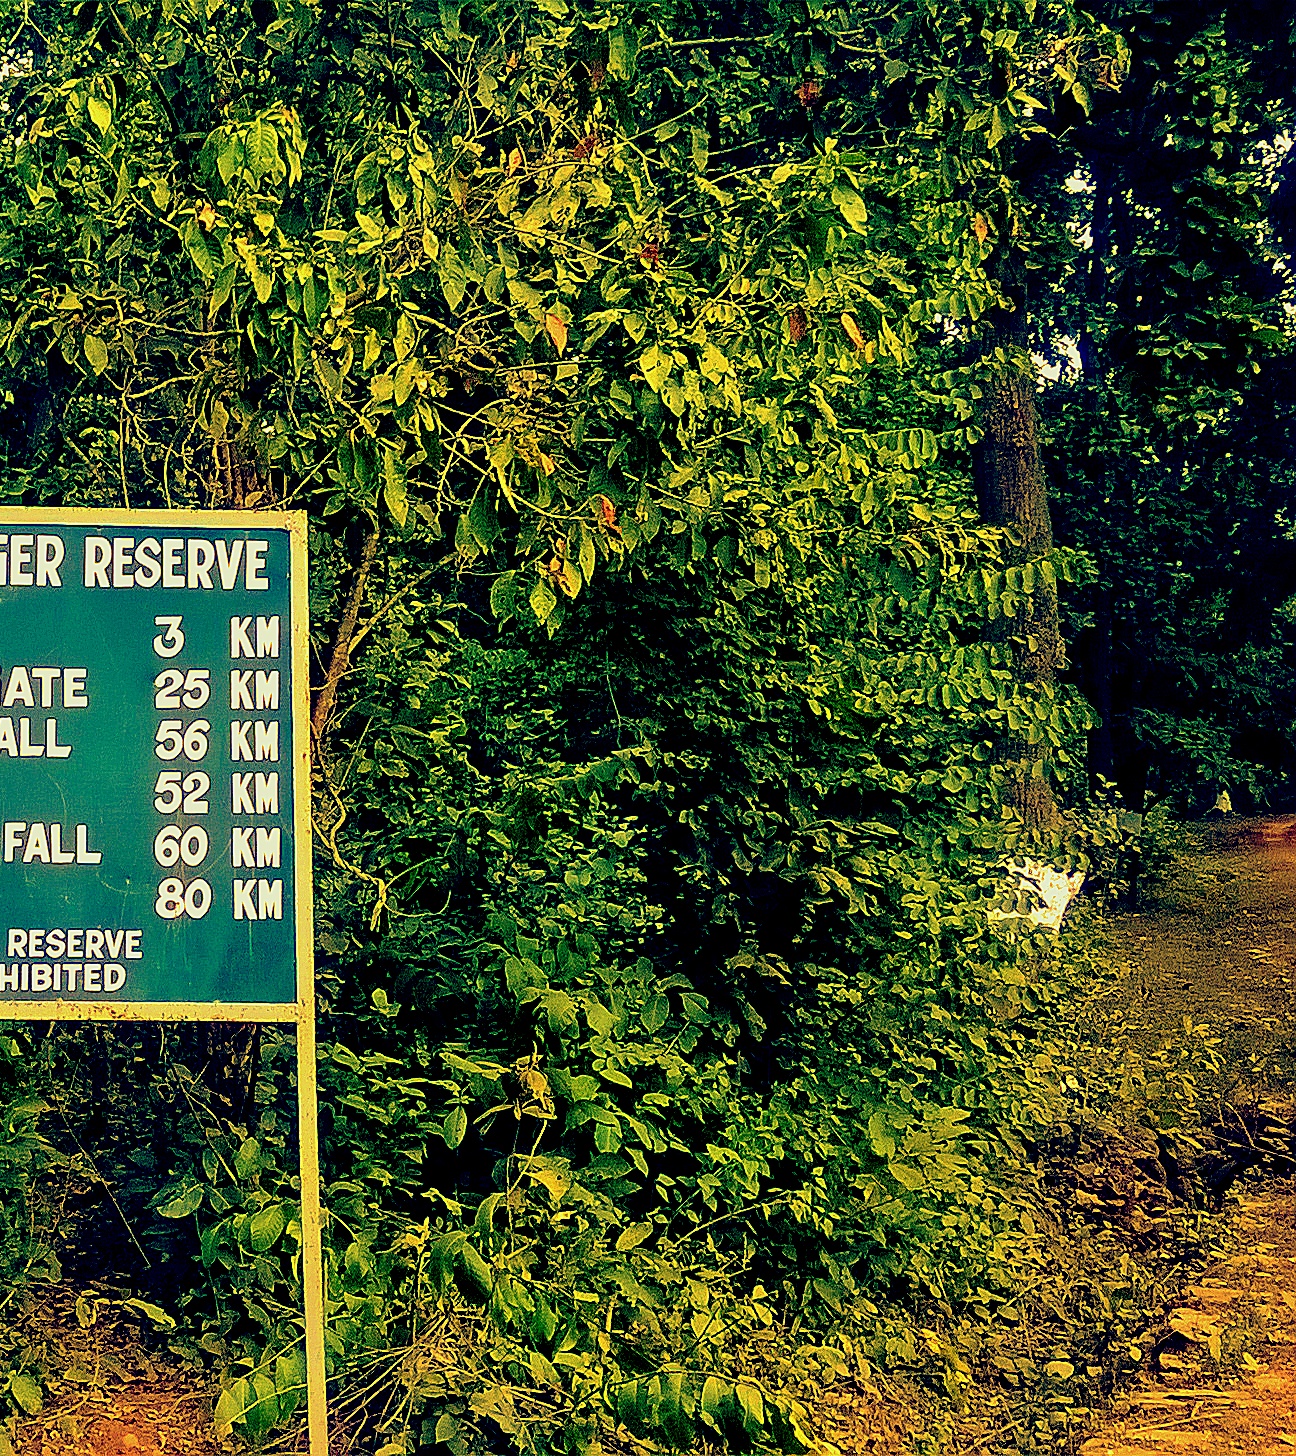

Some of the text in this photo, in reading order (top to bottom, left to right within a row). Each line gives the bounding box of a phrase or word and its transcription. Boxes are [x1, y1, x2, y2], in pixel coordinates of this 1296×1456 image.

[84, 536, 269, 590] RESERVE
[153, 615, 185, 658] 3
[230, 616, 280, 658] KM
[153, 669, 210, 709] 25
[230, 669, 280, 710] KM
[155, 719, 211, 761] 56
[230, 720, 280, 762] KM
[154, 771, 211, 815] 52
[231, 772, 280, 815] KM
[3, 821, 102, 864] FALL
[154, 825, 209, 868] 60
[232, 827, 281, 868] KM
[155, 877, 212, 920] 80
[233, 878, 283, 921] KM
[7, 928, 143, 959] RESERVE
